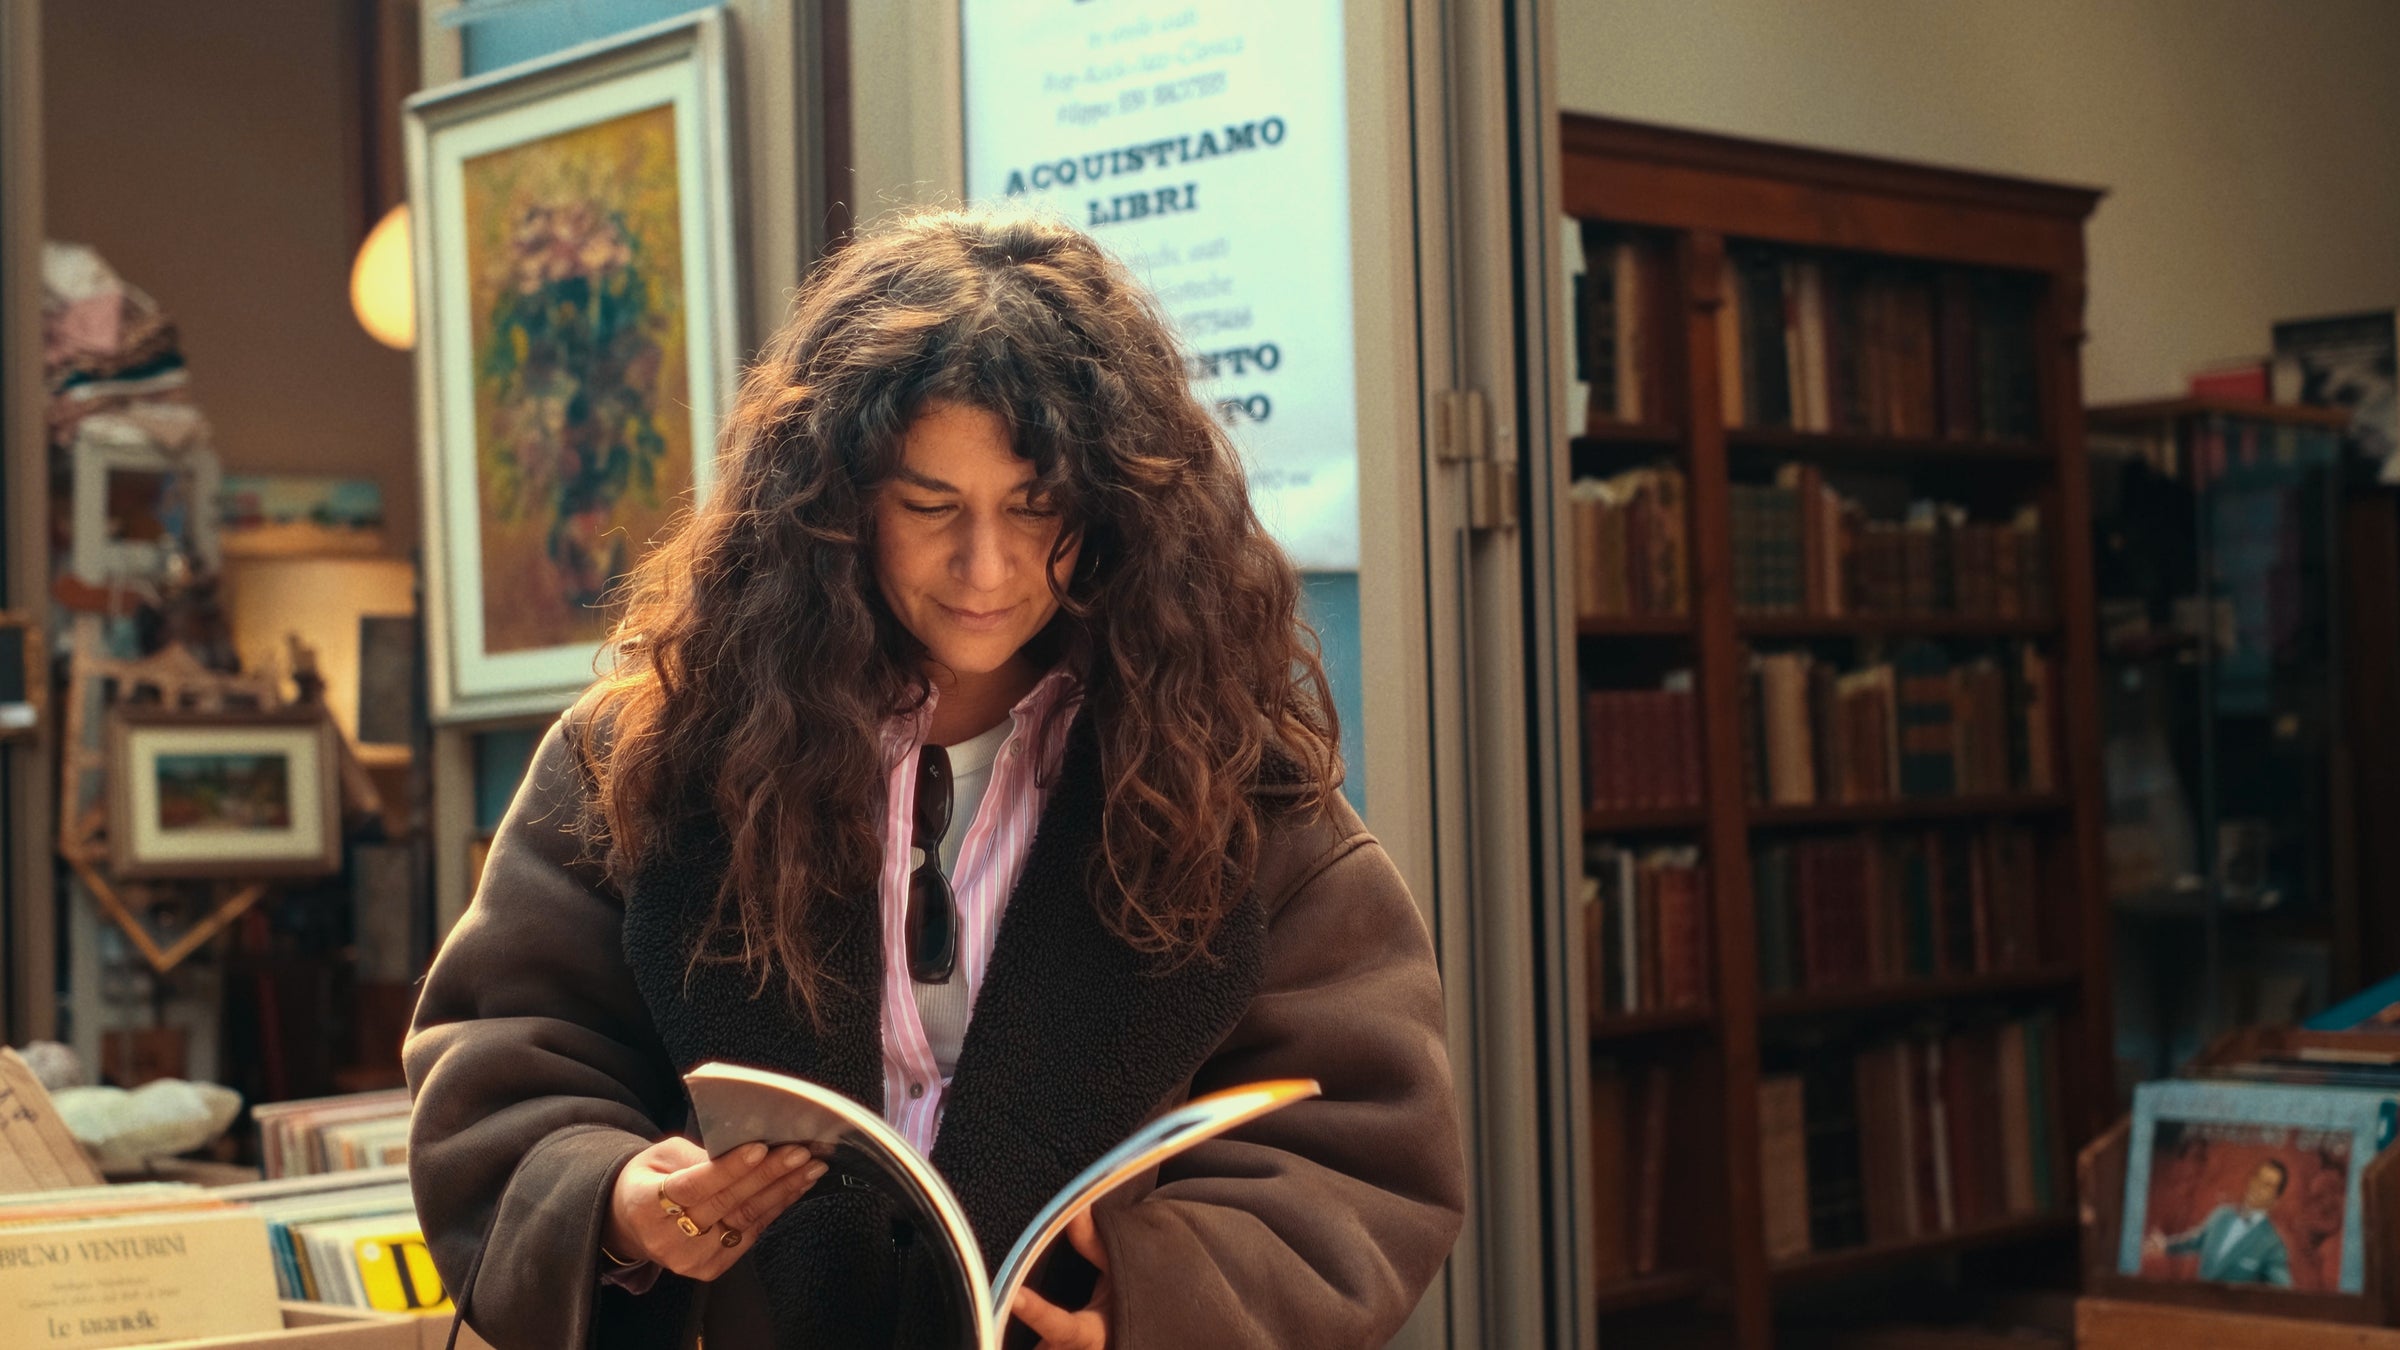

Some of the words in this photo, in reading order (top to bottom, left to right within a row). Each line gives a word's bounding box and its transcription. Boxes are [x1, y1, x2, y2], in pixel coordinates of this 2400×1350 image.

[1005, 117, 1286, 197] ACQUISTIAMO
[1088, 184, 1199, 226] LIBRI
[1189, 342, 1280, 378] NTO
[1216, 392, 1272, 425] TO
[0, 1243, 71, 1268] BRUNO
[77, 1231, 188, 1262] VENTURINI
